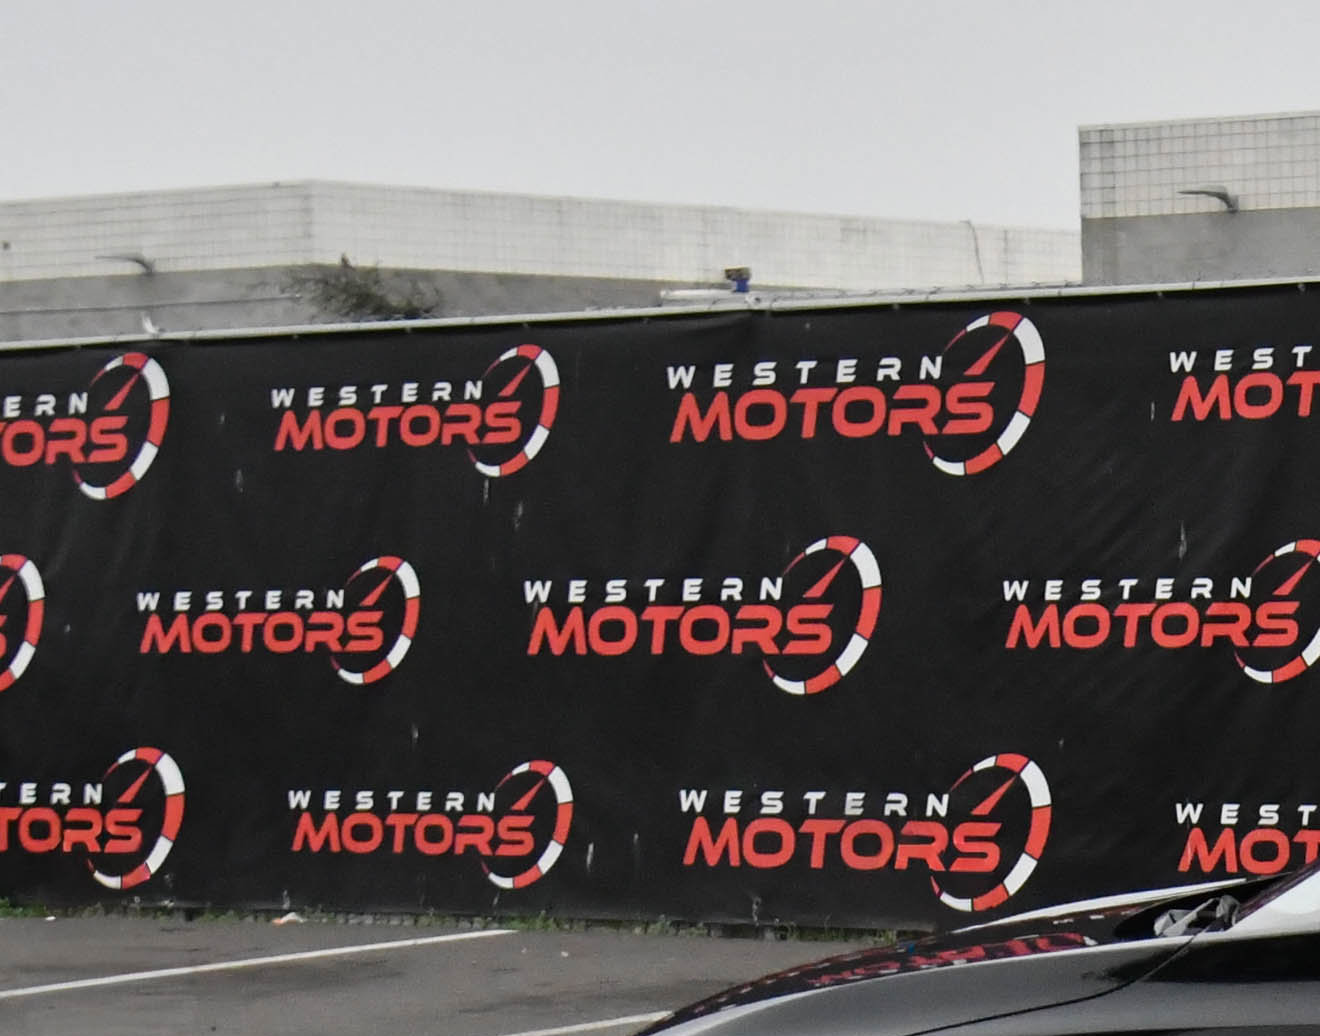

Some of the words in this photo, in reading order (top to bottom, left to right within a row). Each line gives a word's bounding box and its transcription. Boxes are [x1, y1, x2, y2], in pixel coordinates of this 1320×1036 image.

[668, 356, 942, 387] WESTERN
[272, 381, 482, 406] WESTERN
[670, 383, 995, 442] MOTORS
[0, 416, 129, 466] ORS
[275, 404, 522, 451] MOTORS
[137, 590, 344, 611] WESTERN
[525, 577, 782, 603] WESTERN
[1003, 577, 1251, 601] WESTERN
[141, 611, 384, 653] MOTORS
[528, 604, 833, 656] MOTORS
[1006, 601, 1299, 648] MOTORS
[289, 791, 495, 810] WESTERN
[680, 790, 949, 816] WESTERN
[292, 811, 534, 855] MOTORS
[684, 816, 1000, 870] MOTORS
